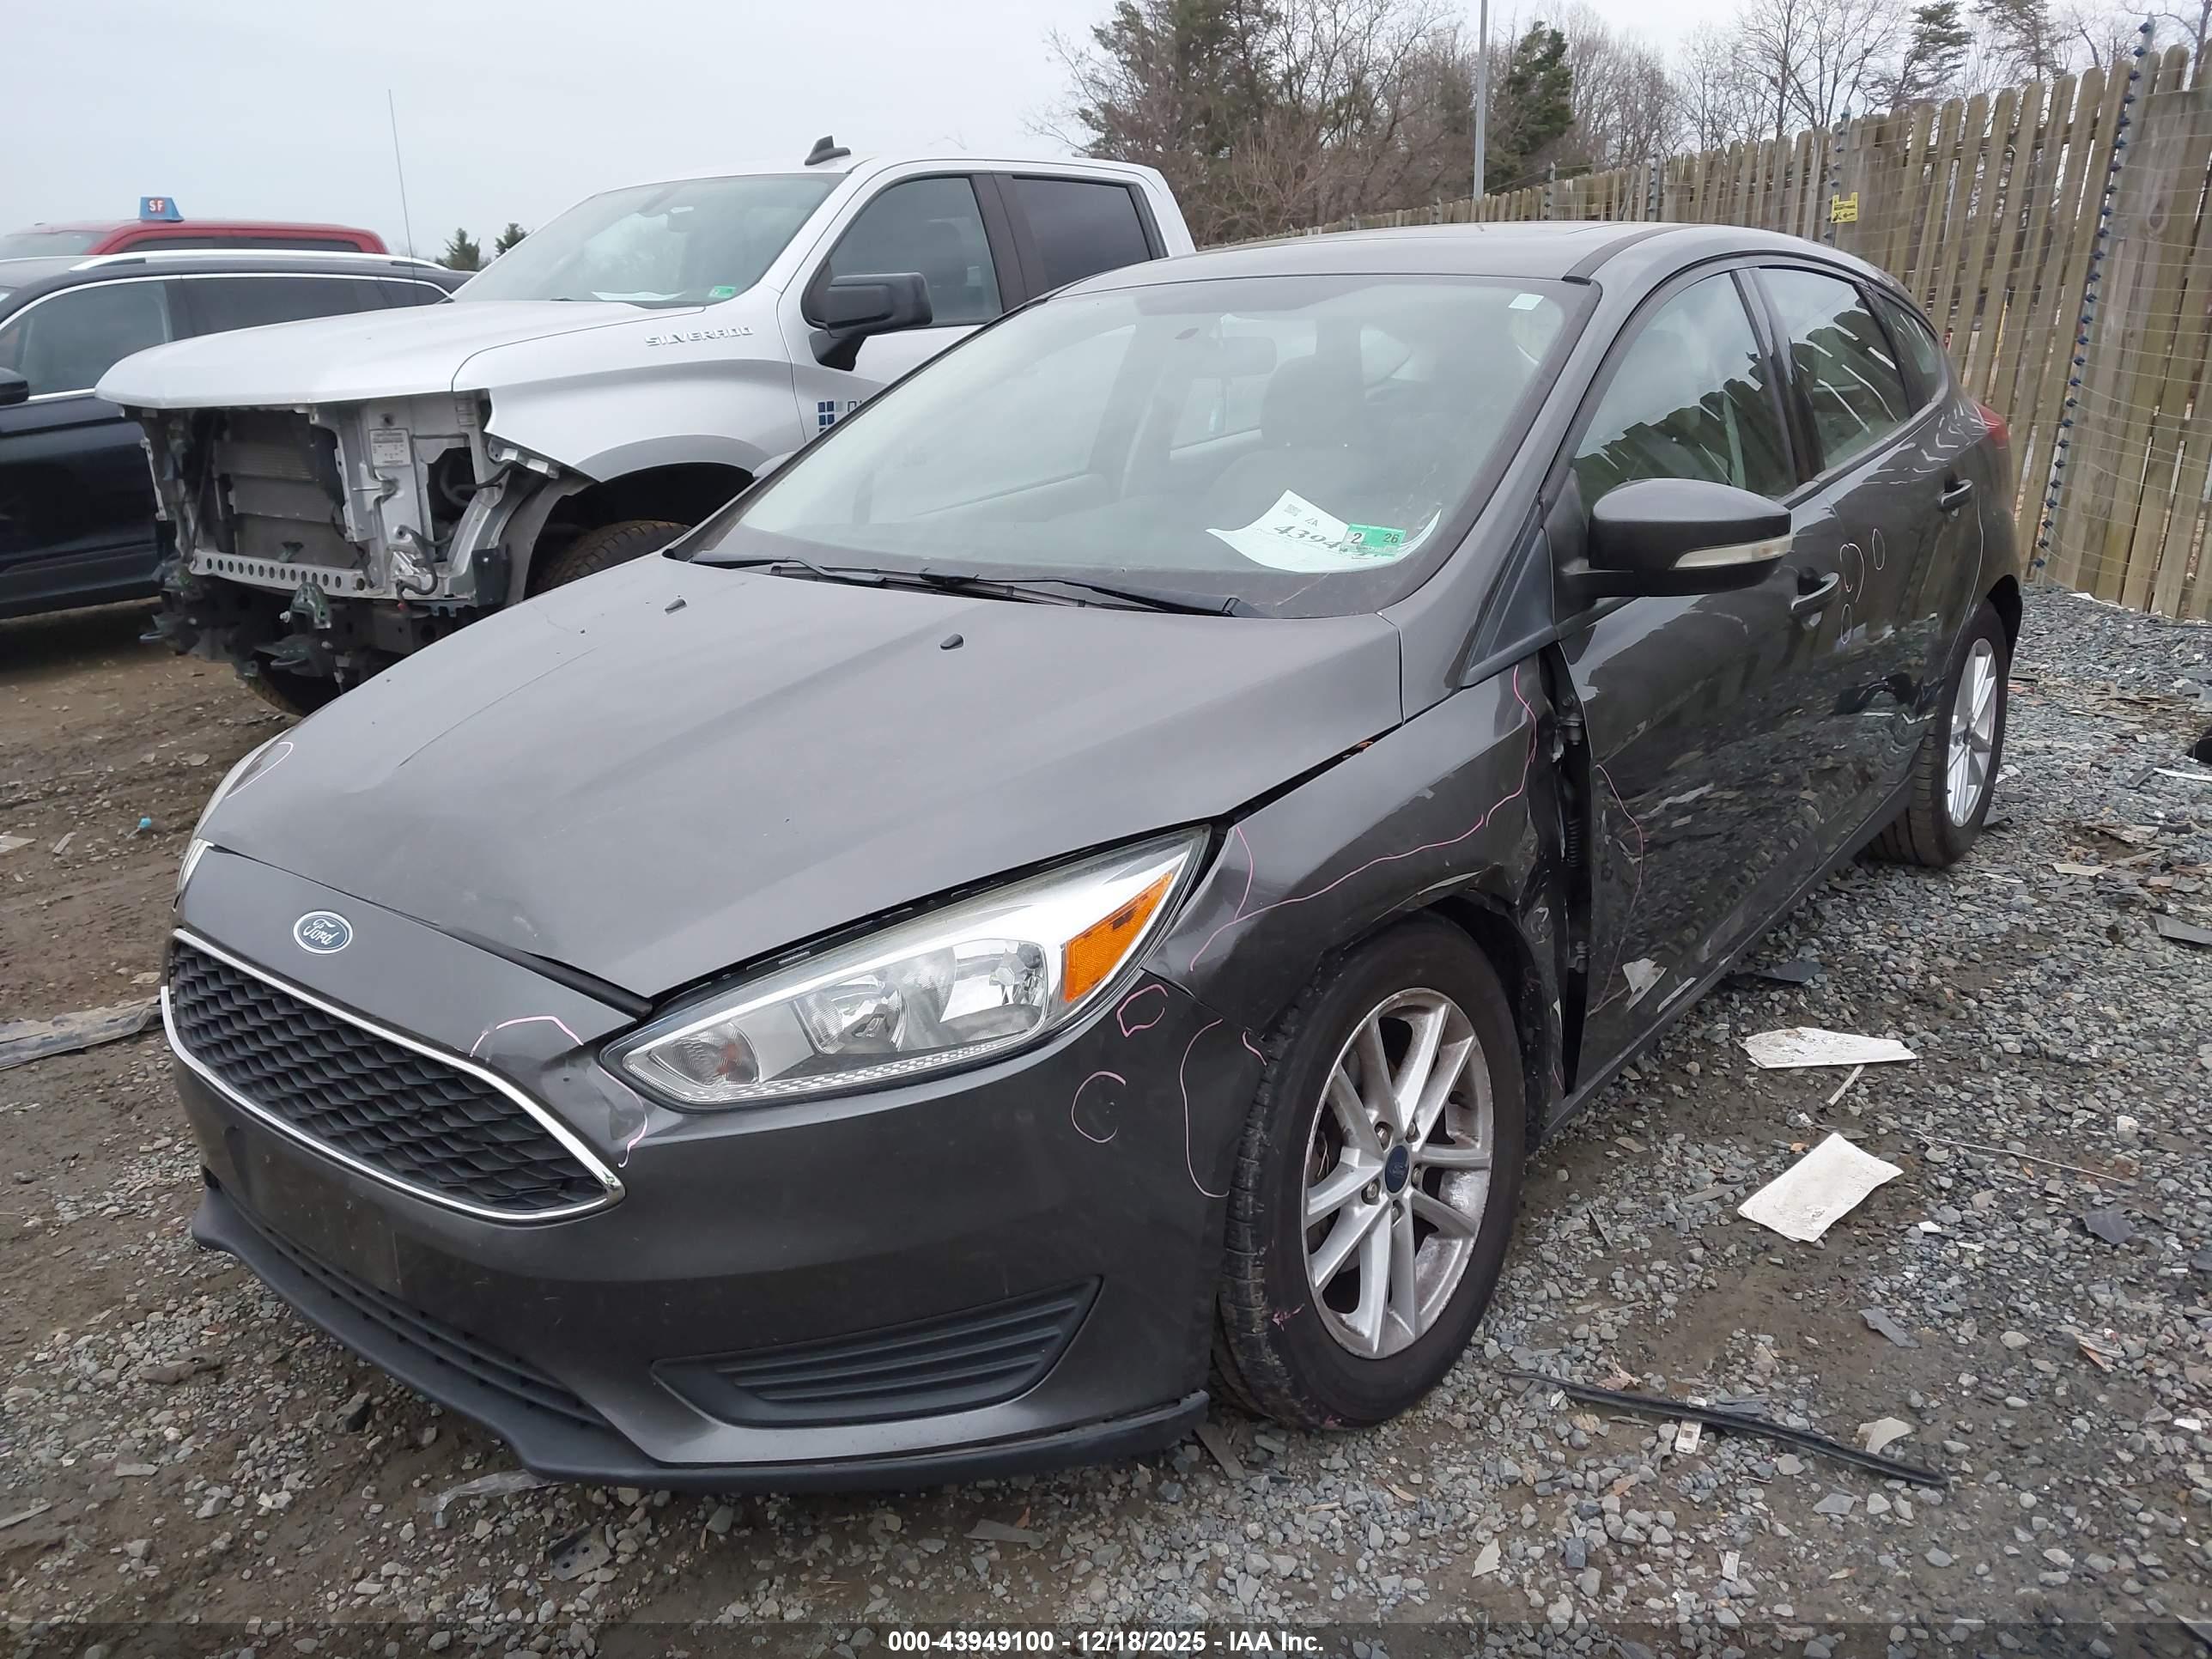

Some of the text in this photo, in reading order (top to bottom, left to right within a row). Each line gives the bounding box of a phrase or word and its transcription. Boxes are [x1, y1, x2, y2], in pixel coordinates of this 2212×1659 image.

[149, 199, 164, 212] SF
[645, 325, 754, 346] SILVERADO
[1351, 532, 1400, 544] 2 26
[302, 918, 340, 945] Ford
